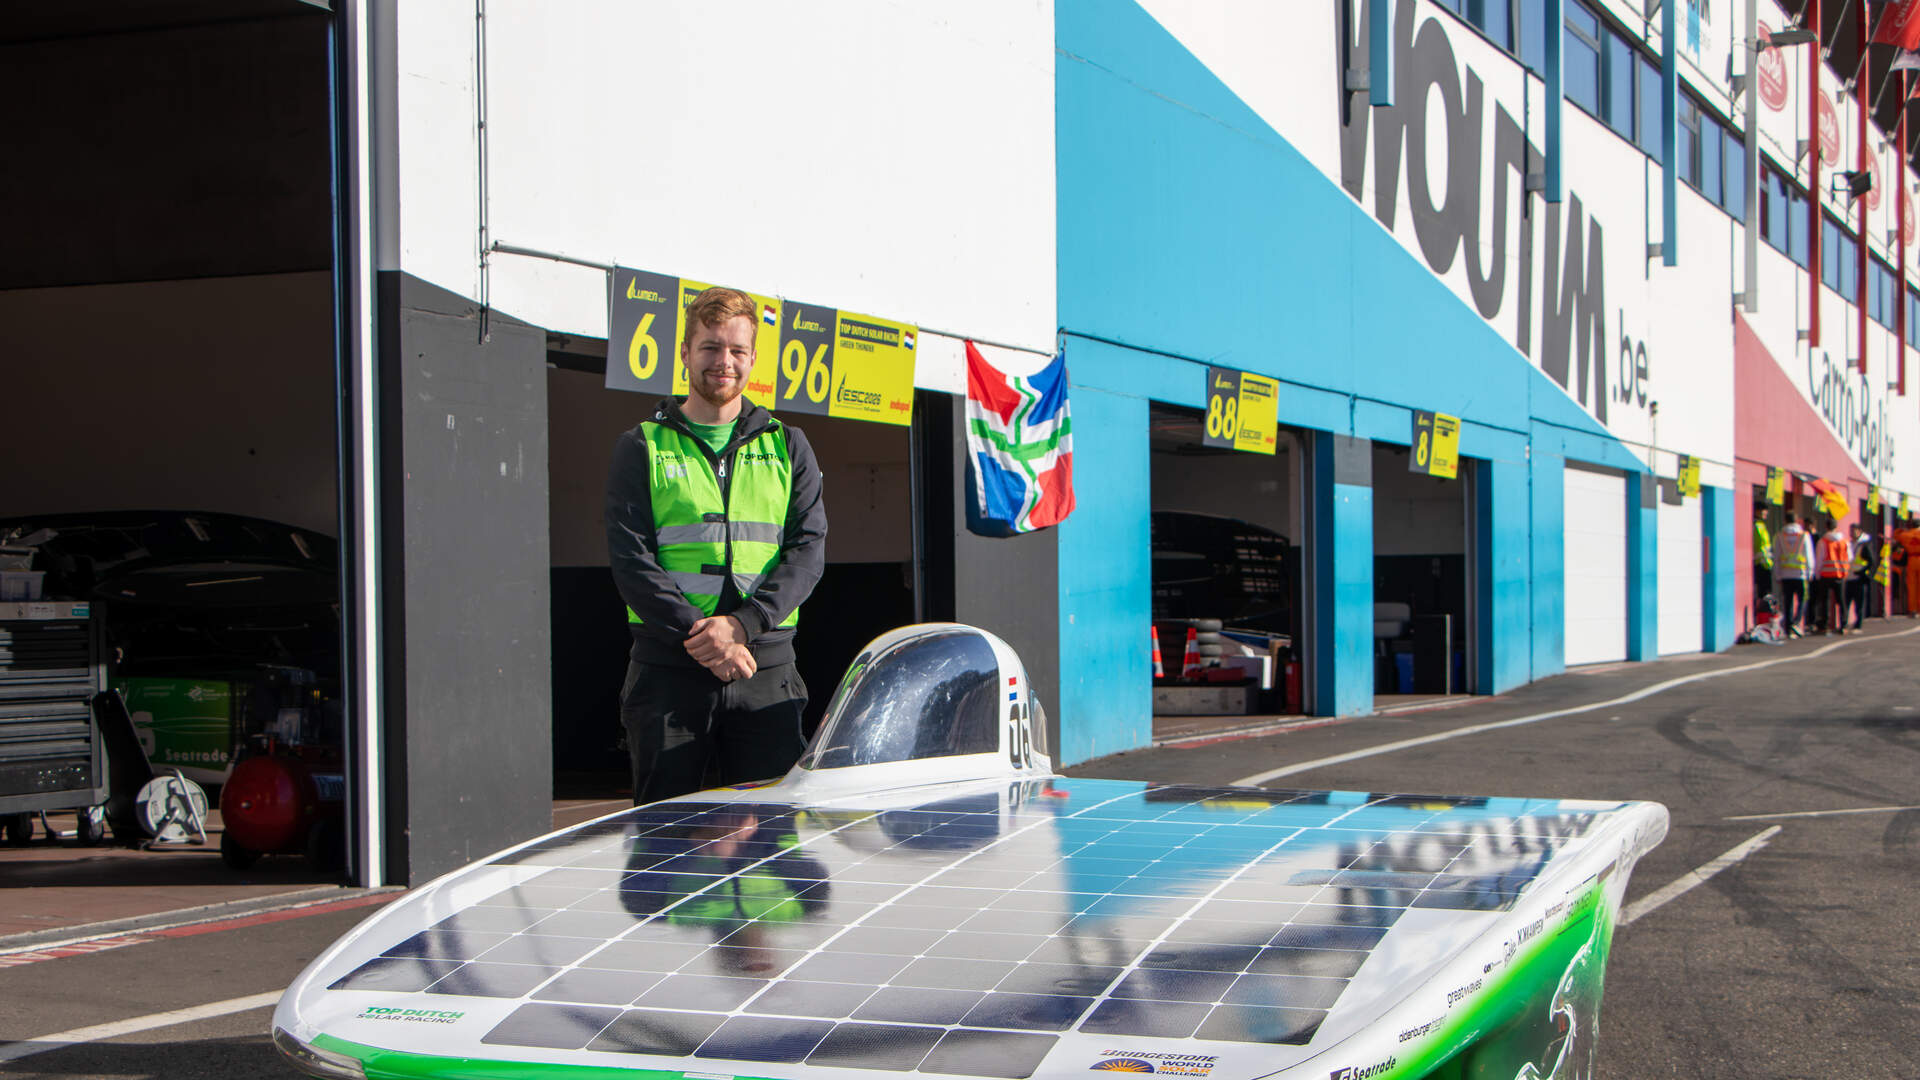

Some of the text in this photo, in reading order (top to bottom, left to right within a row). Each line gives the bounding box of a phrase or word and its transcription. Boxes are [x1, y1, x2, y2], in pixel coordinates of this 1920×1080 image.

[628, 312, 659, 381] 6
[781, 339, 830, 403] 96
[1207, 394, 1237, 440] 88
[1416, 431, 1429, 466] 8
[165, 747, 229, 762] Seatrade
[401, 1009, 465, 1018] DUTCH
[404, 1016, 457, 1024] RACING
[1100, 1050, 1220, 1062] BRIDGESTONE
[1161, 1060, 1214, 1068] WORLD
[1352, 1055, 1397, 1080] Seatrade
